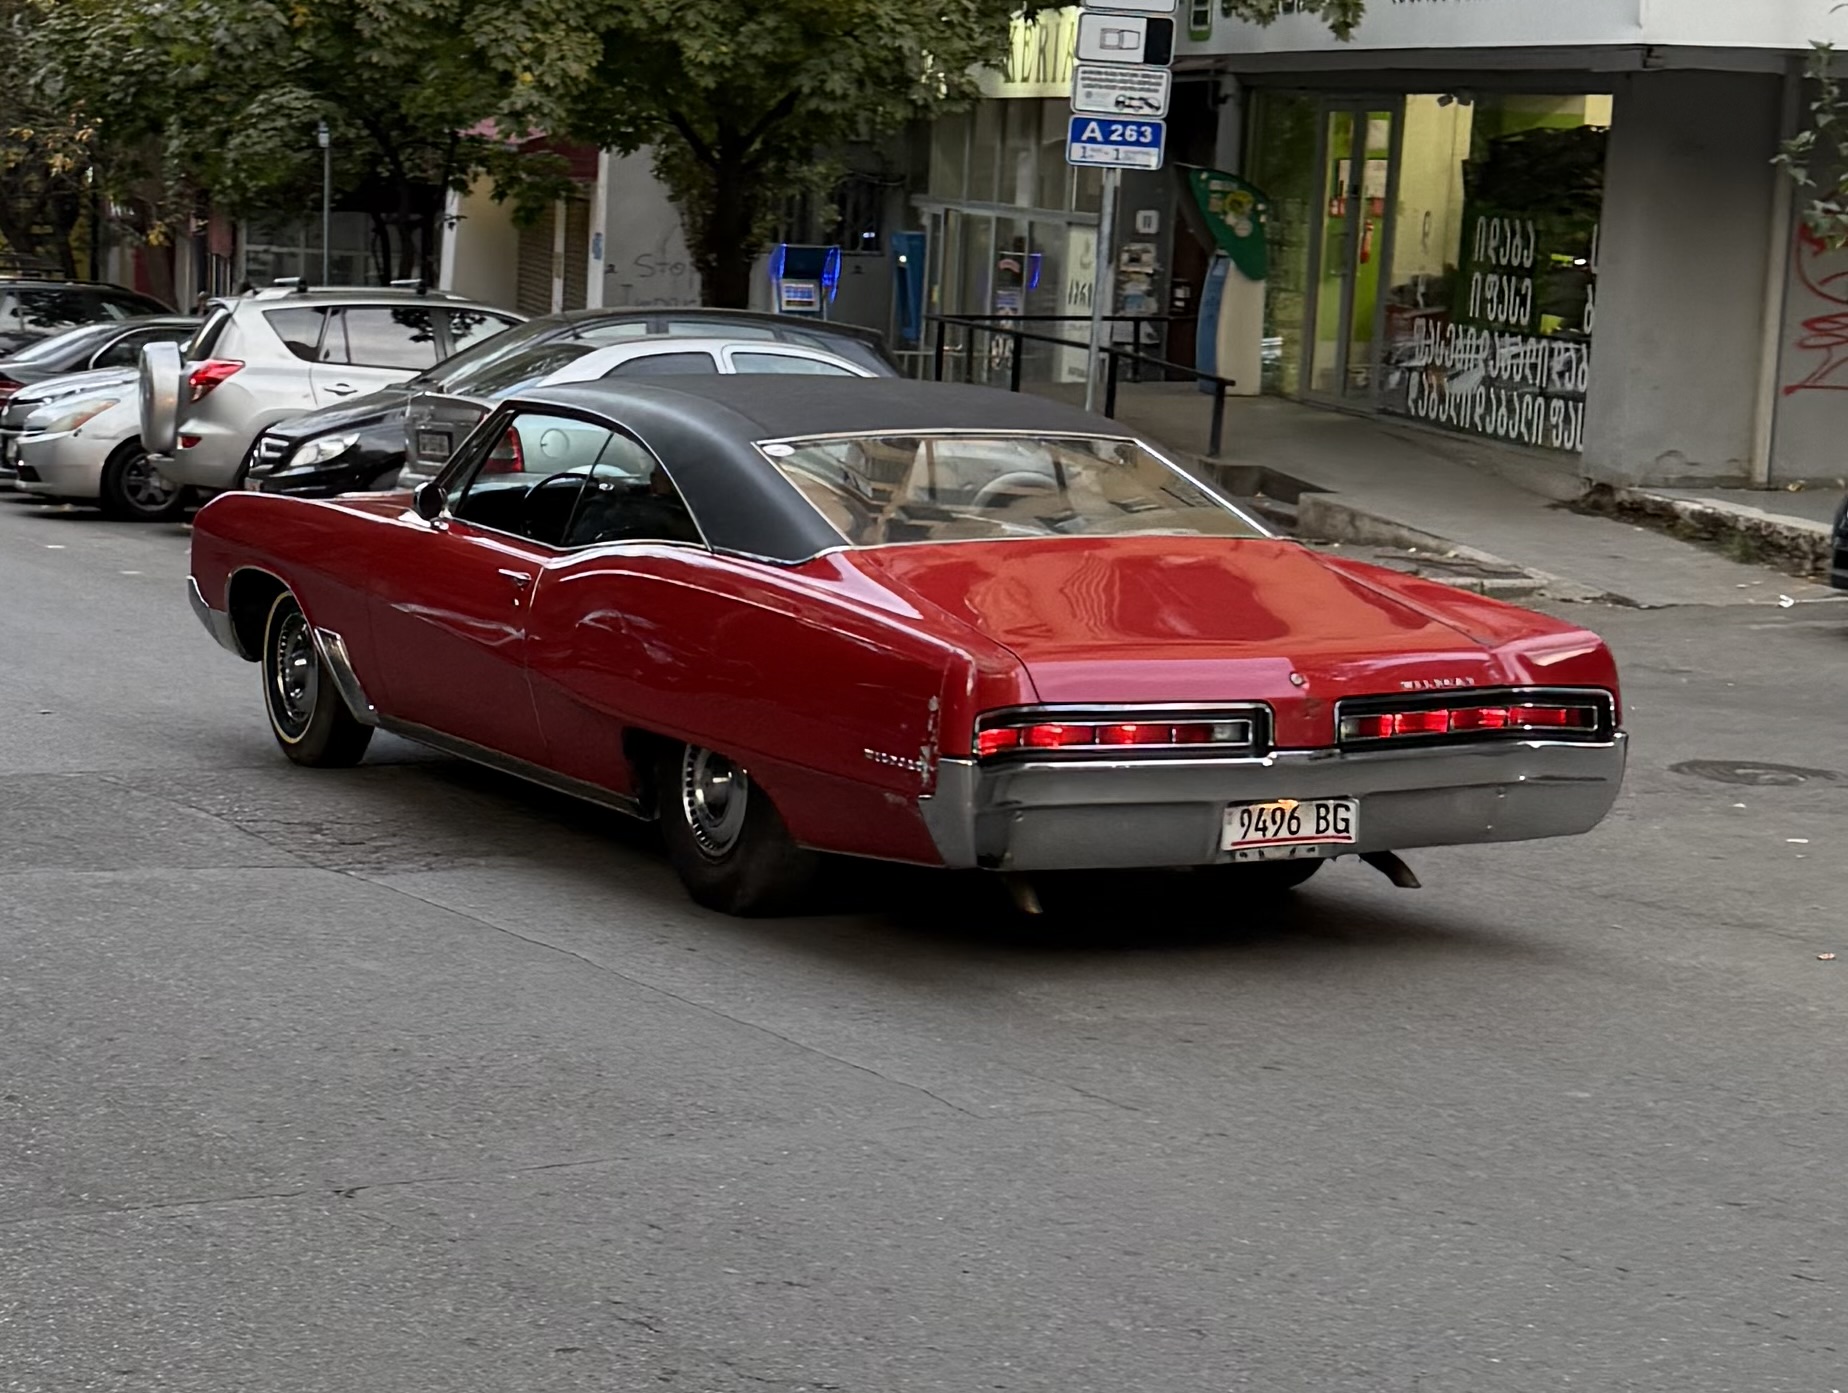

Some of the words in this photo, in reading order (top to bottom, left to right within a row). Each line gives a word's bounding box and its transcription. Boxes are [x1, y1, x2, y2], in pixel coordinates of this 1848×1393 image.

[1081, 120, 1104, 142] A
[1109, 123, 1153, 143] 263
[1240, 804, 1301, 839] 9496
[1315, 803, 1351, 835] BG
